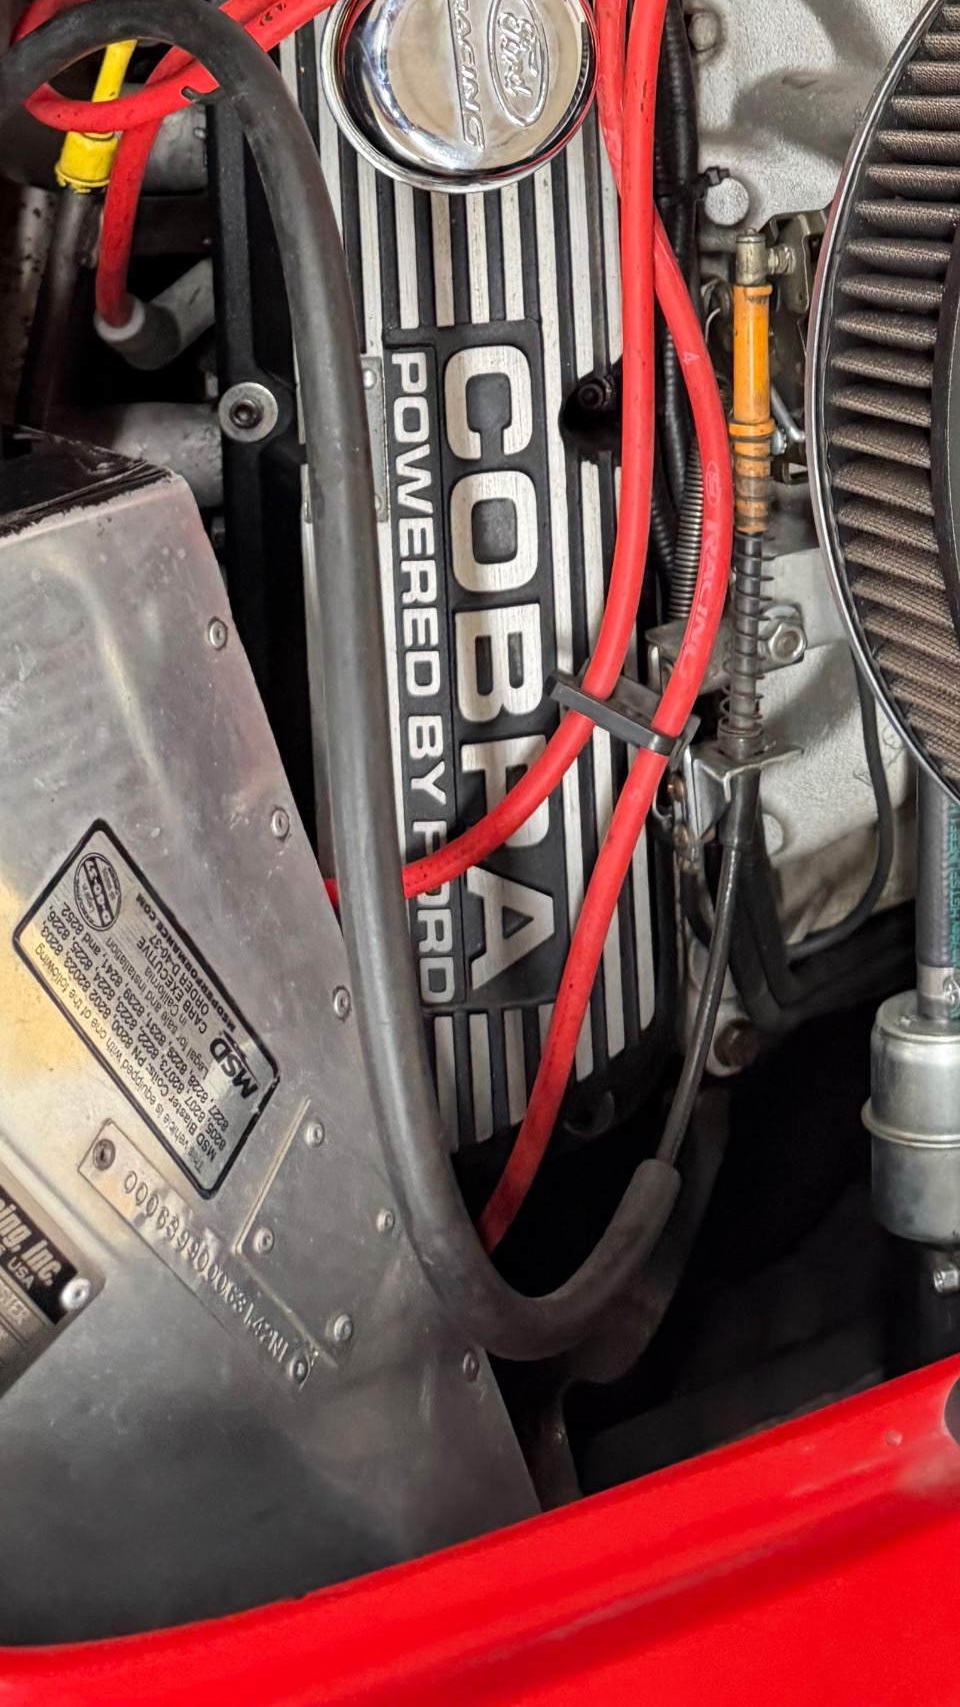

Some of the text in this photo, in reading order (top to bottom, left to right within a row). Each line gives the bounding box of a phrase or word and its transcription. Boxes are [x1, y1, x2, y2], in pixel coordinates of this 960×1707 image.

[498, 11, 540, 98] Ford
[391, 351, 442, 698] POWERED
[444, 345, 555, 991] COBRA
[407, 714, 448, 806] BY
[57, 899, 85, 937] 8252.
[31, 940, 72, 994] following
[81, 930, 101, 958] and
[134, 889, 236, 1035] MSDPERFORMANCE.COM
[97, 950, 125, 988] 8241,
[134, 933, 208, 1036] CARB EXECUTIVE
[147, 929, 210, 1018] ORDER D-40-37
[65, 986, 84, 1012] the
[78, 1003, 92, 1023] of
[103, 934, 211, 1080] Legal for sale and installation
[119, 981, 146, 1018] 8239,
[141, 964, 188, 1028] in California
[36, 918, 217, 1162] MSD Blaster Coils: PN 8200, 8202 82023, 8203,
[43, 903, 228, 1152] 8205, 8207, 82073, 8222, 8223, 8224, 8225, 8226,
[88, 1015, 108, 1042] one
[102, 1035, 124, 1065] with
[141, 1010, 168, 1048] 8231,
[118, 1054, 158, 1109] equipped
[184, 1068, 210, 1105] 8228,
[206, 1030, 259, 1106] MSD
[152, 1101, 164, 1119] is
[159, 1111, 190, 1152] vehicle
[205, 1097, 230, 1133] 8227,
[7, 1256, 35, 1290] USA
[21, 1239, 62, 1287] Inc.
